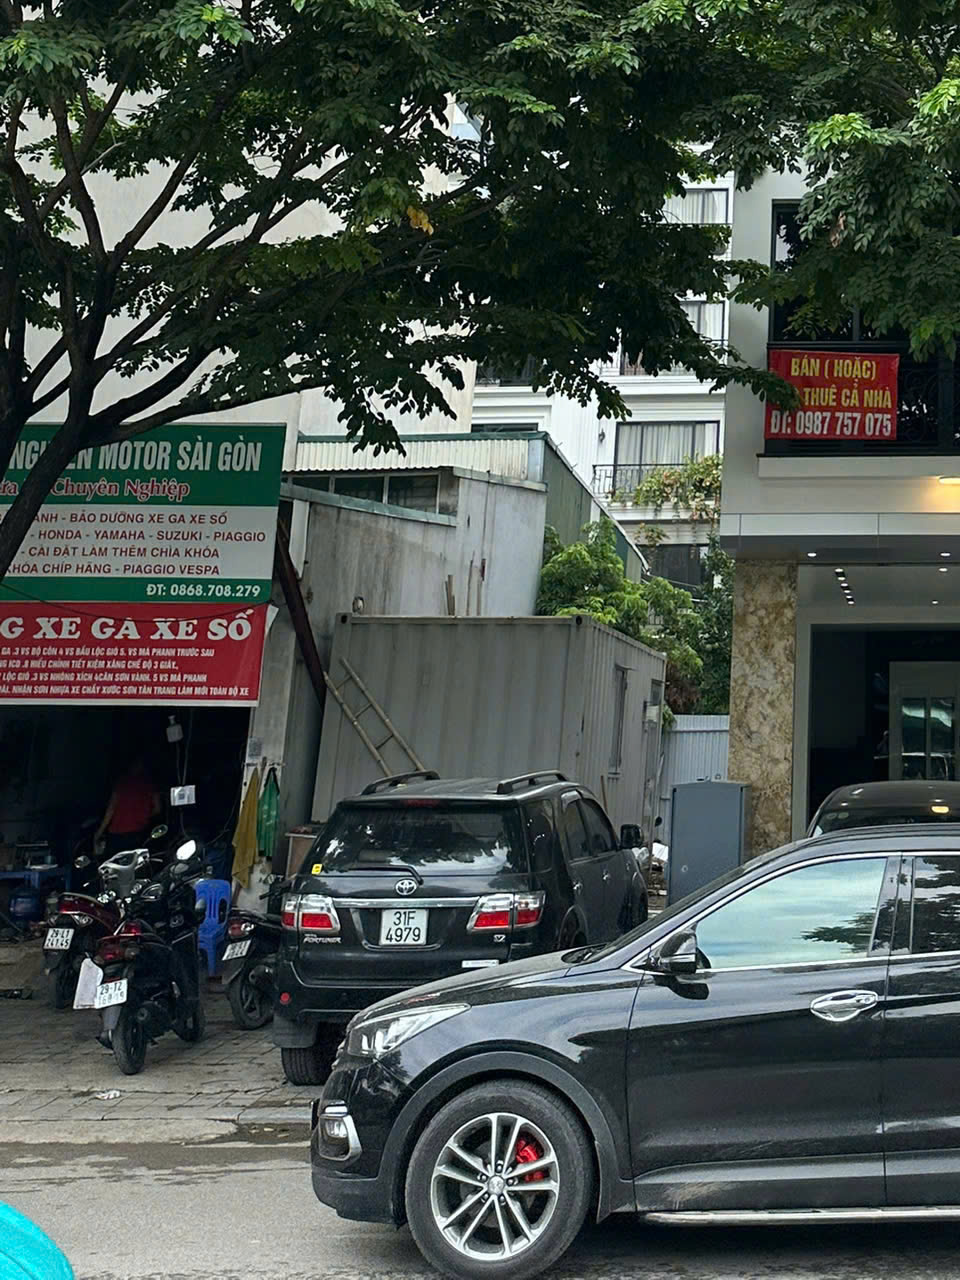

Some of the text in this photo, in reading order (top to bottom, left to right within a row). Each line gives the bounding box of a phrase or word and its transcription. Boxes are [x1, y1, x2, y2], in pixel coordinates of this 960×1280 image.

[791, 355, 820, 377] BÁN
[803, 382, 892, 408] THUÊ CẢ NHÀ
[795, 411, 831, 435] 0987
[835, 412, 861, 436] 757
[865, 413, 891, 436] 075
[98, 440, 172, 470] MOTOR
[176, 435, 213, 471] SÀI
[217, 435, 262, 471] GÒN
[50, 477, 190, 502] Chuyên Nghiệp
[70, 509, 97, 523] BẢO
[100, 511, 144, 523] DƯỠNG
[148, 513, 165, 524] XE
[168, 514, 186, 524] GA
[189, 514, 206, 524] XE
[209, 511, 228, 525] SỐ
[38, 529, 266, 542] HONDA YAMAHA SUZUKI PIAGGIO
[82, 544, 108, 557] LÀM
[112, 544, 147, 557] THÊM
[150, 545, 180, 558] CHÌA
[184, 545, 220, 558] KHÓA
[123, 564, 176, 575] PIAGGIO
[179, 564, 220, 575] VESPA
[146, 584, 261, 597] ĐT: 0868.708.279
[33, 617, 81, 639] XE
[91, 617, 141, 640] GA
[150, 618, 198, 640] XE
[207, 608, 254, 640] SỐ
[200, 647, 215, 657] SAU
[71, 685, 81, 695] XE
[239, 687, 249, 696] XE
[393, 910, 416, 926] 31F
[385, 927, 422, 943] 4979
